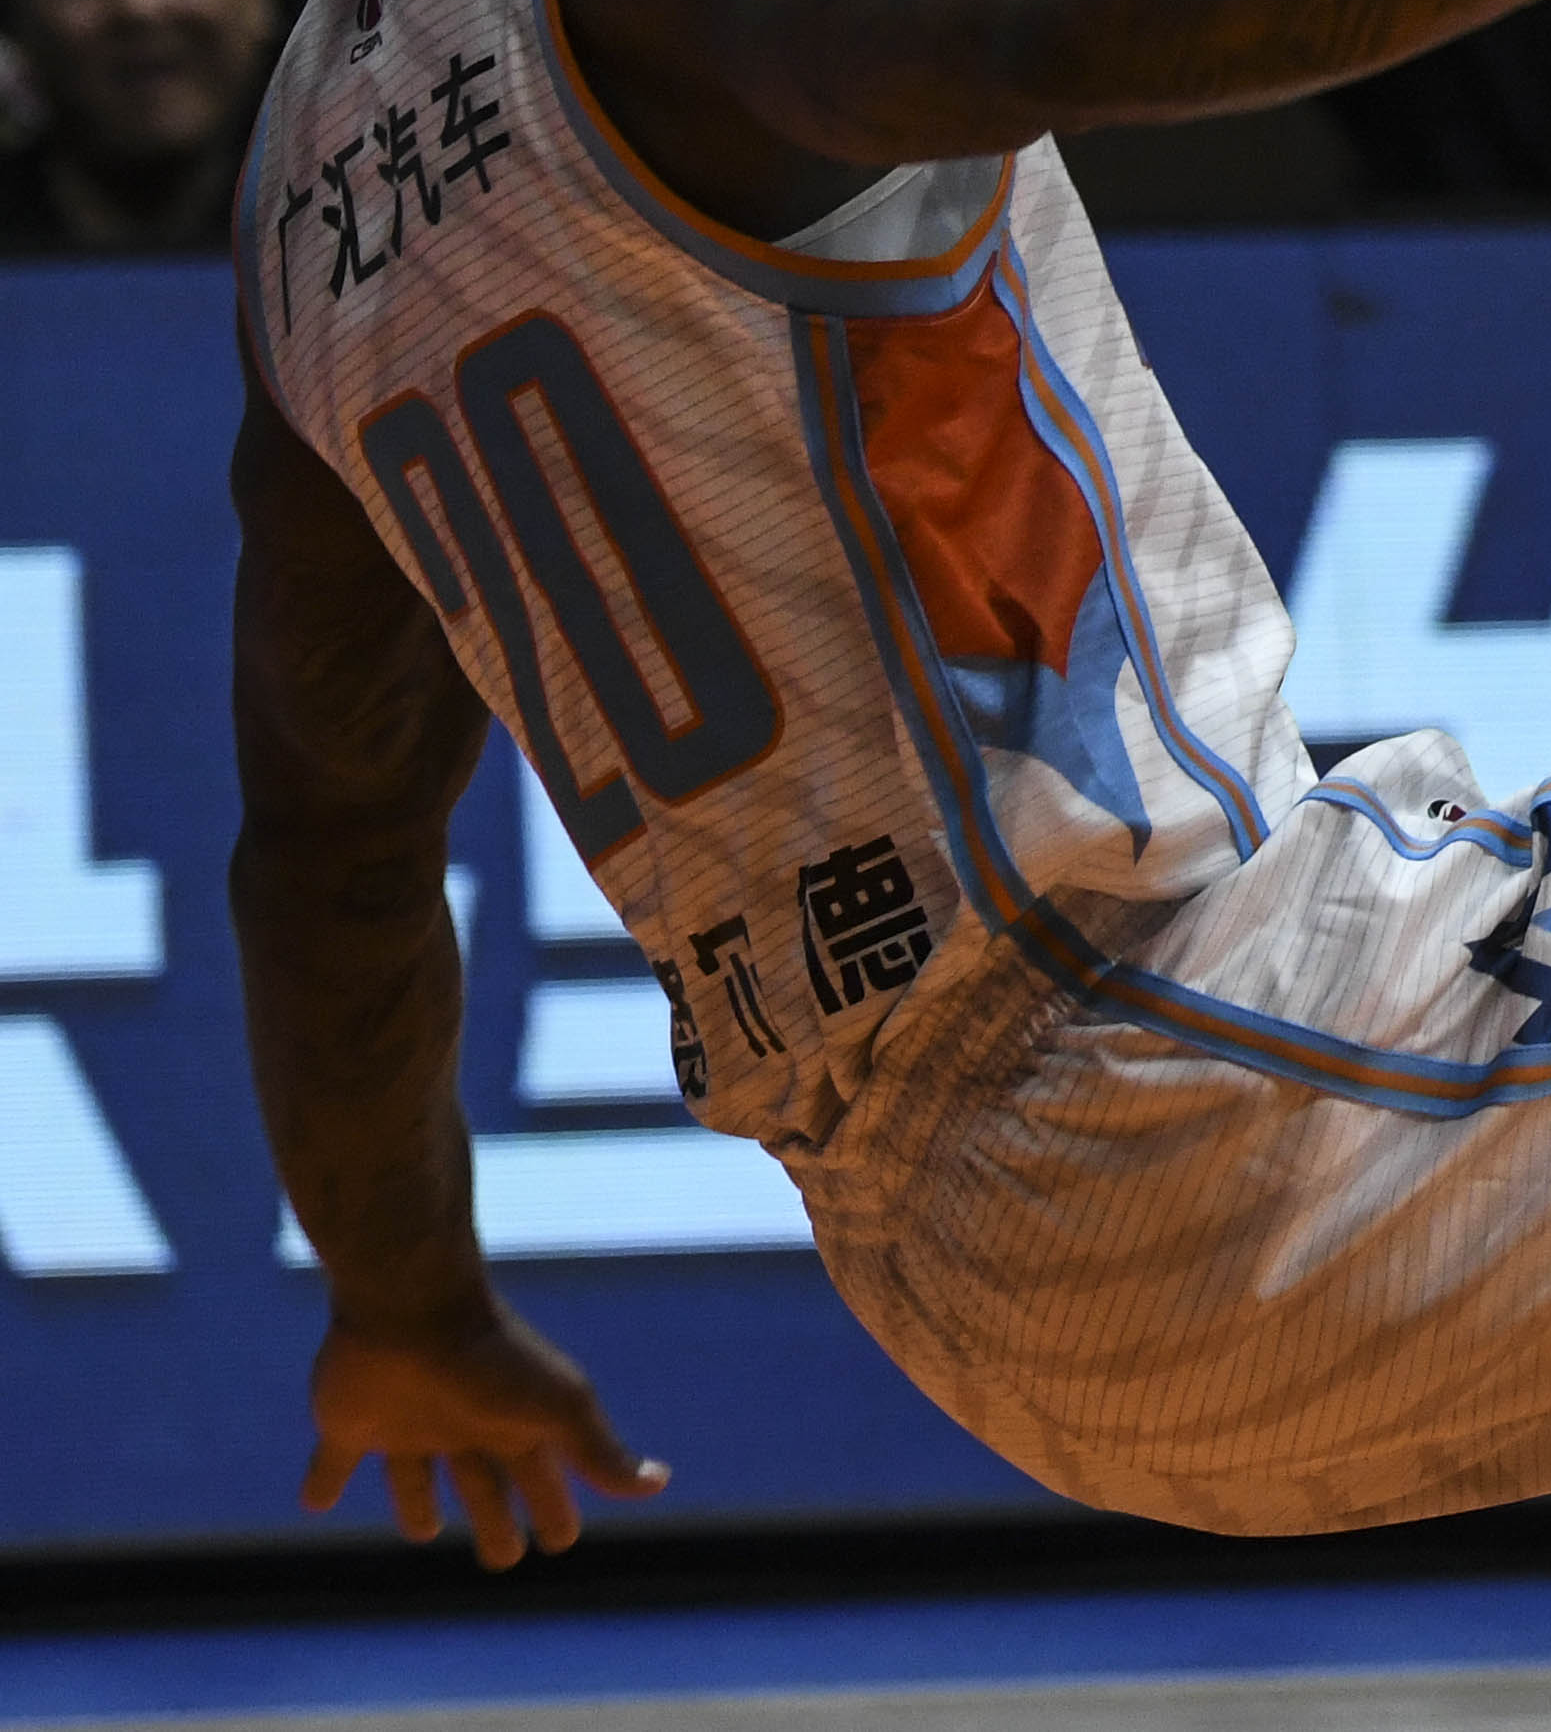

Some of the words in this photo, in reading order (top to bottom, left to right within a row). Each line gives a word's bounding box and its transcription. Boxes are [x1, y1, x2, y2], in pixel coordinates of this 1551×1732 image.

[278, 53, 511, 336] 广汇汽车
[357, 307, 786, 869] 20
